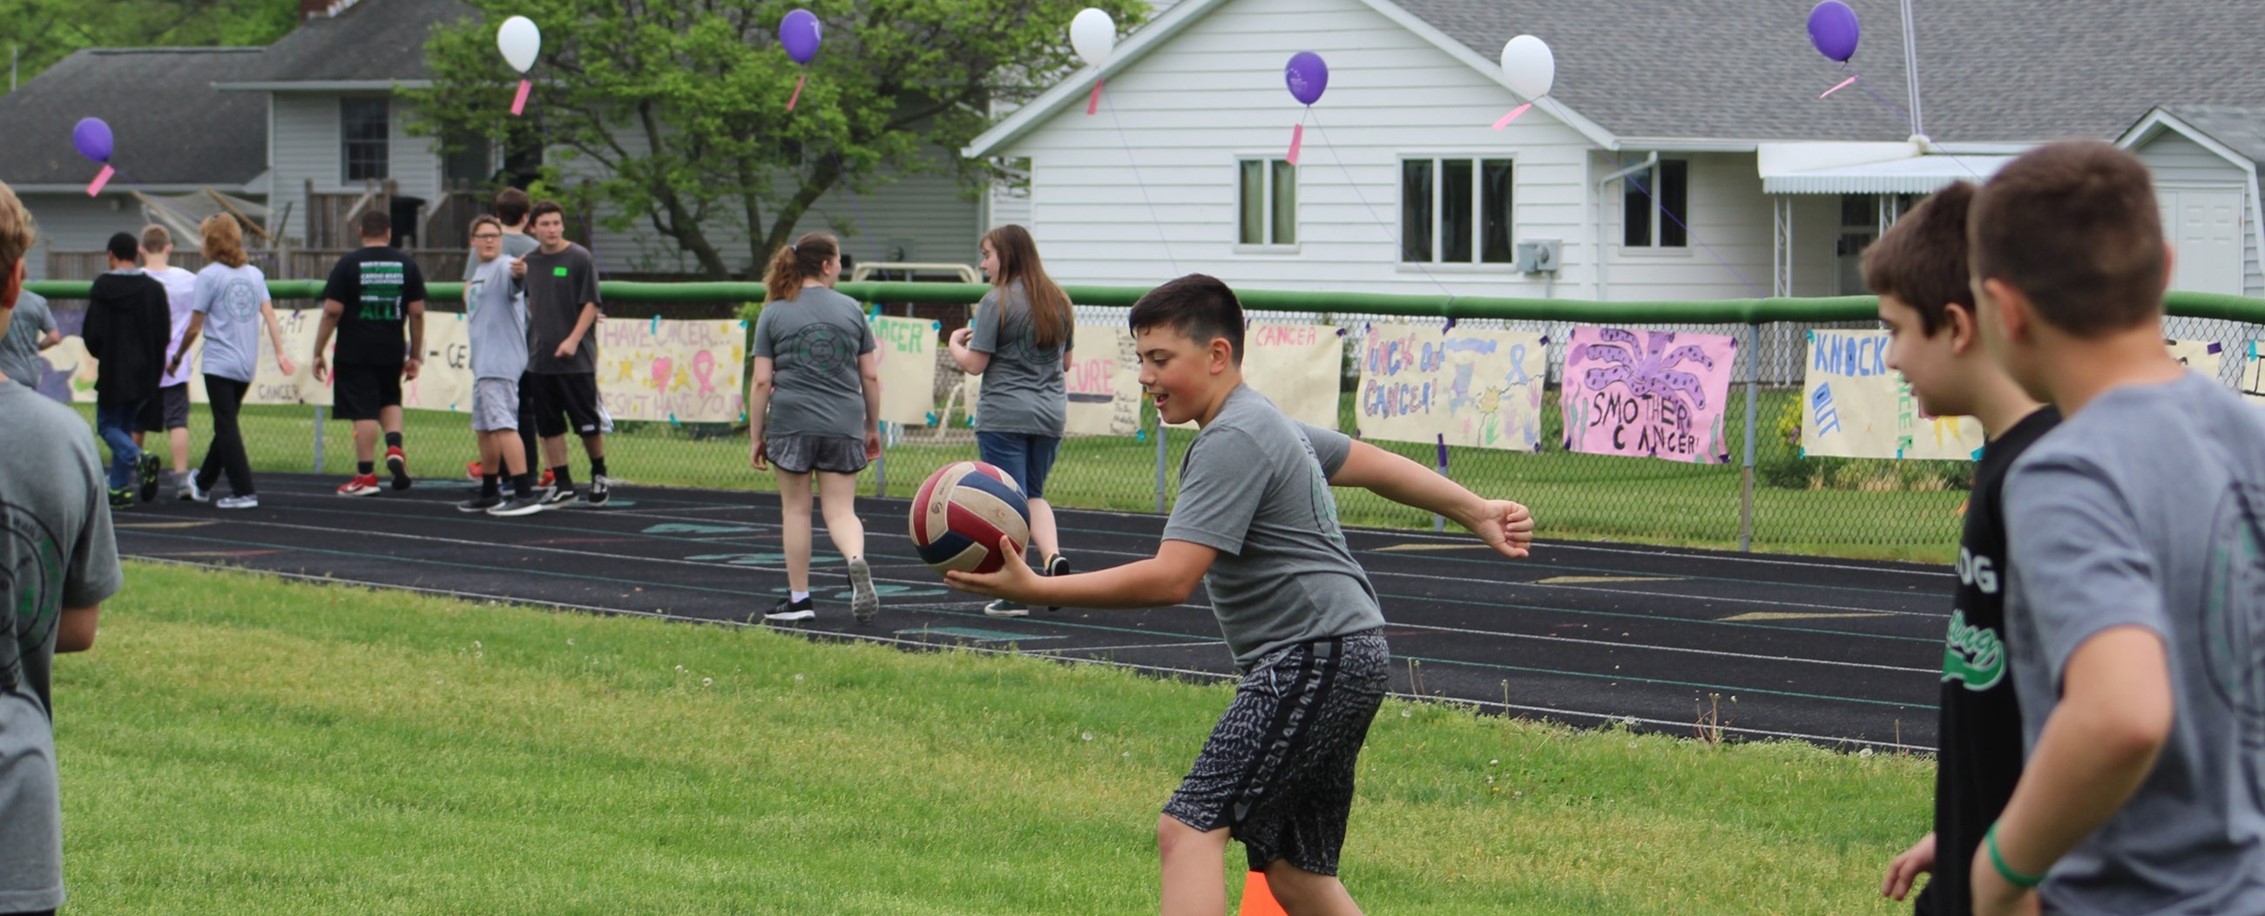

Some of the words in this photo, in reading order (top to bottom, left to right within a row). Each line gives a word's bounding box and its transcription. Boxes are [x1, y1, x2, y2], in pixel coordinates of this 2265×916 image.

[1256, 325, 1316, 347] CANCER
[1814, 333, 1888, 377] KNOCK
[1066, 359, 1114, 393] CURE
[1364, 377, 1438, 419] CANCER!
[1590, 391, 1688, 429] SMOTHER
